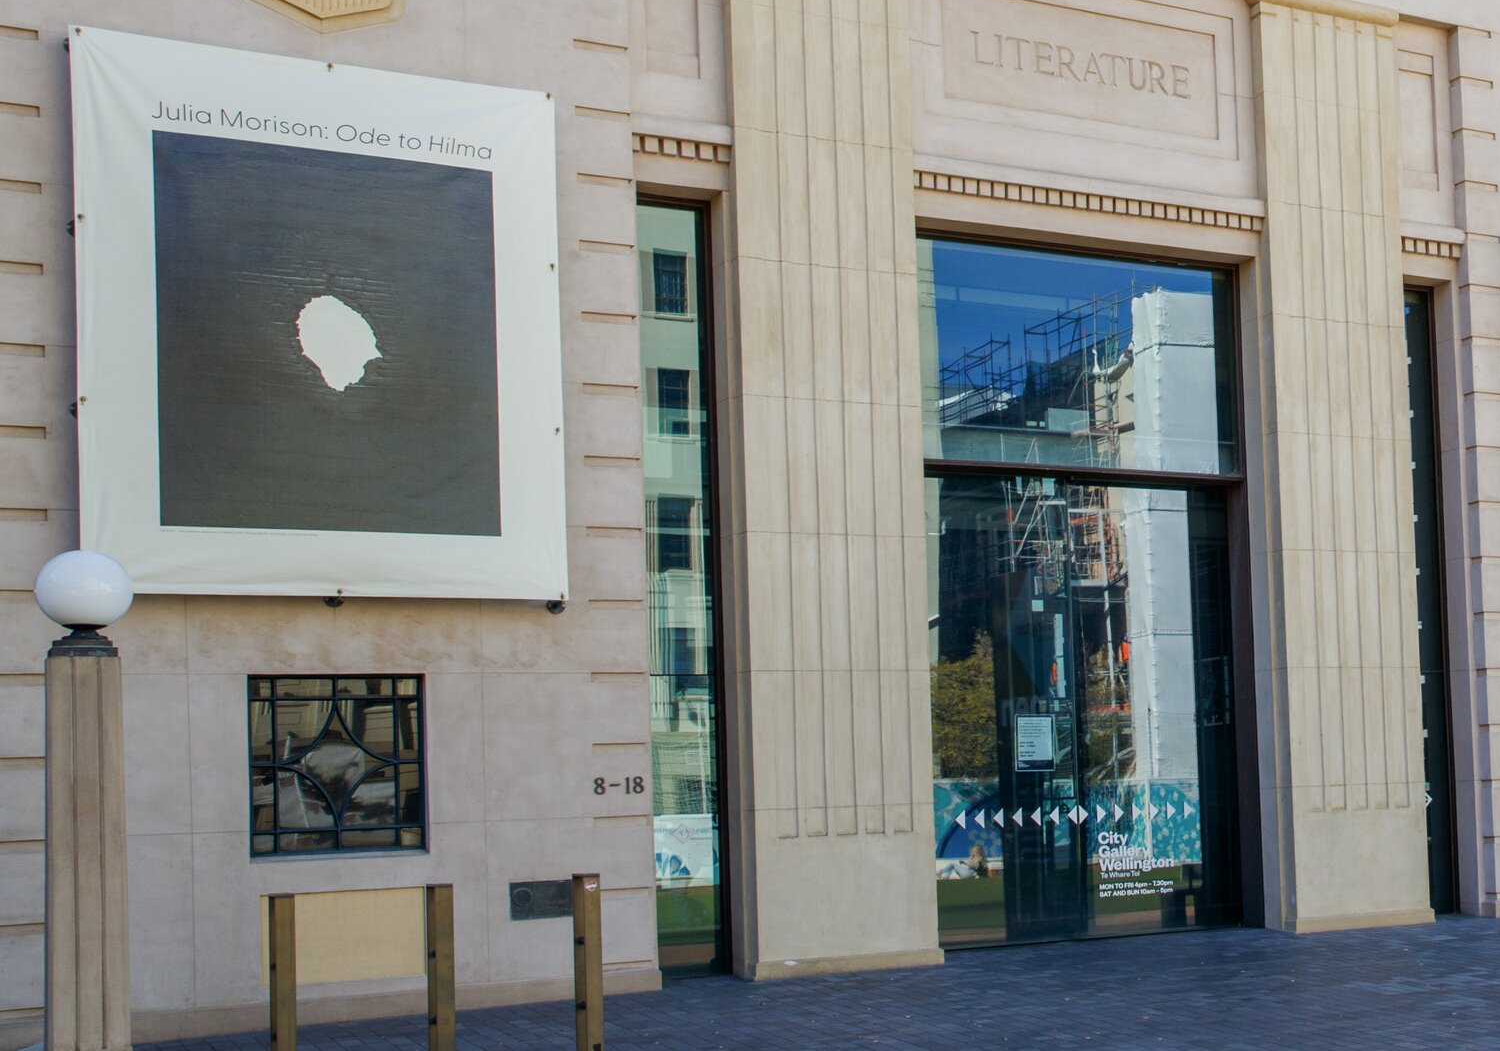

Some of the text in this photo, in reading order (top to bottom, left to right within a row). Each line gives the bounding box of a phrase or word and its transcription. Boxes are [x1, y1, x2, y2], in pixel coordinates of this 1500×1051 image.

[969, 29, 1191, 100] LITERATURE
[151, 100, 493, 160] Julia Morison: Ode to Hilma
[1097, 830, 1128, 845] City
[1098, 844, 1149, 859] Gallery
[1099, 856, 1174, 872] Wellington
[1134, 881, 1147, 889] 4pm
